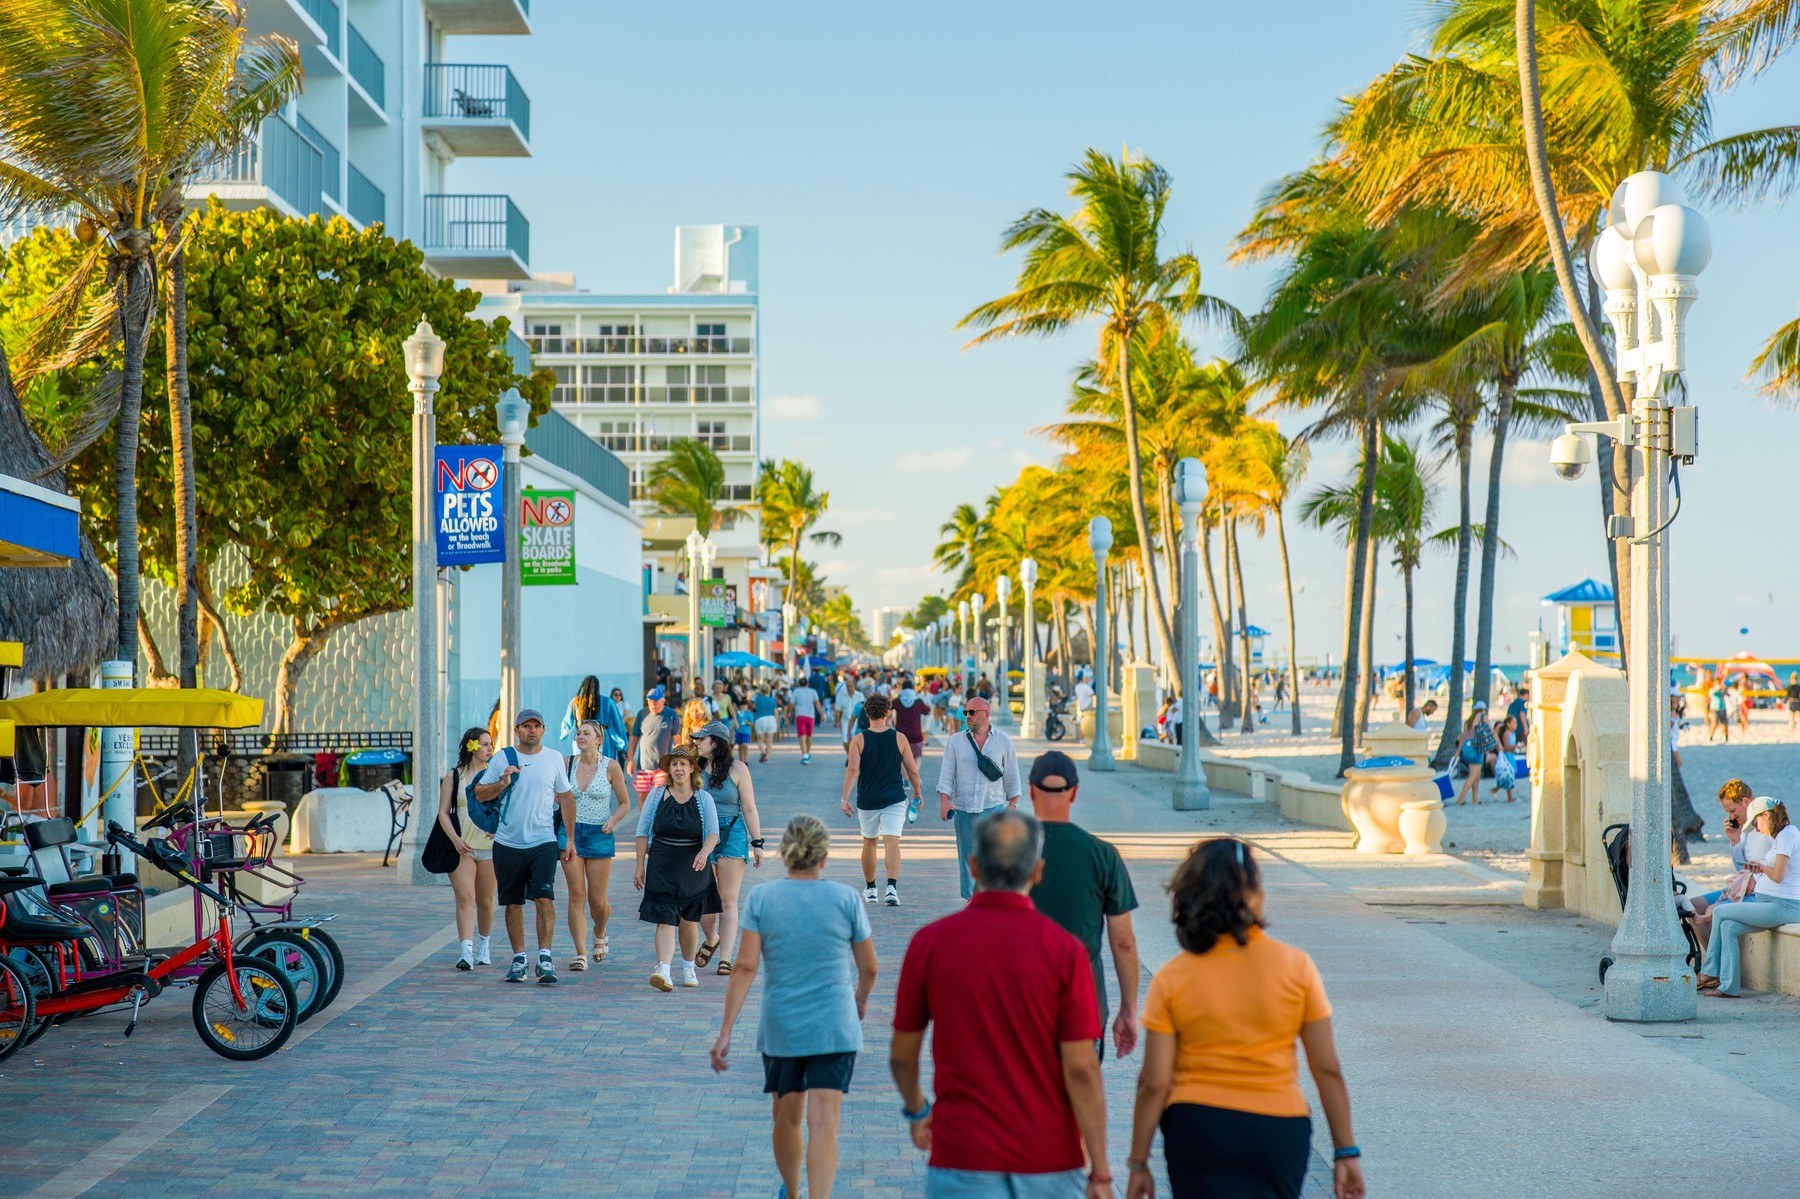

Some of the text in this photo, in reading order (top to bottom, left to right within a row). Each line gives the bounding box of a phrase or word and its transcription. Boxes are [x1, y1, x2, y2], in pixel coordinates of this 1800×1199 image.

[438, 458, 498, 492] NO
[443, 491, 493, 519] PETS
[521, 497, 572, 527] NO
[440, 517, 498, 534] ALLOWED
[458, 533, 469, 541] the
[470, 532, 490, 540] beach
[522, 526, 572, 546] SKATE
[456, 541, 491, 550] Broadwalk
[522, 545, 572, 560] BOARDS
